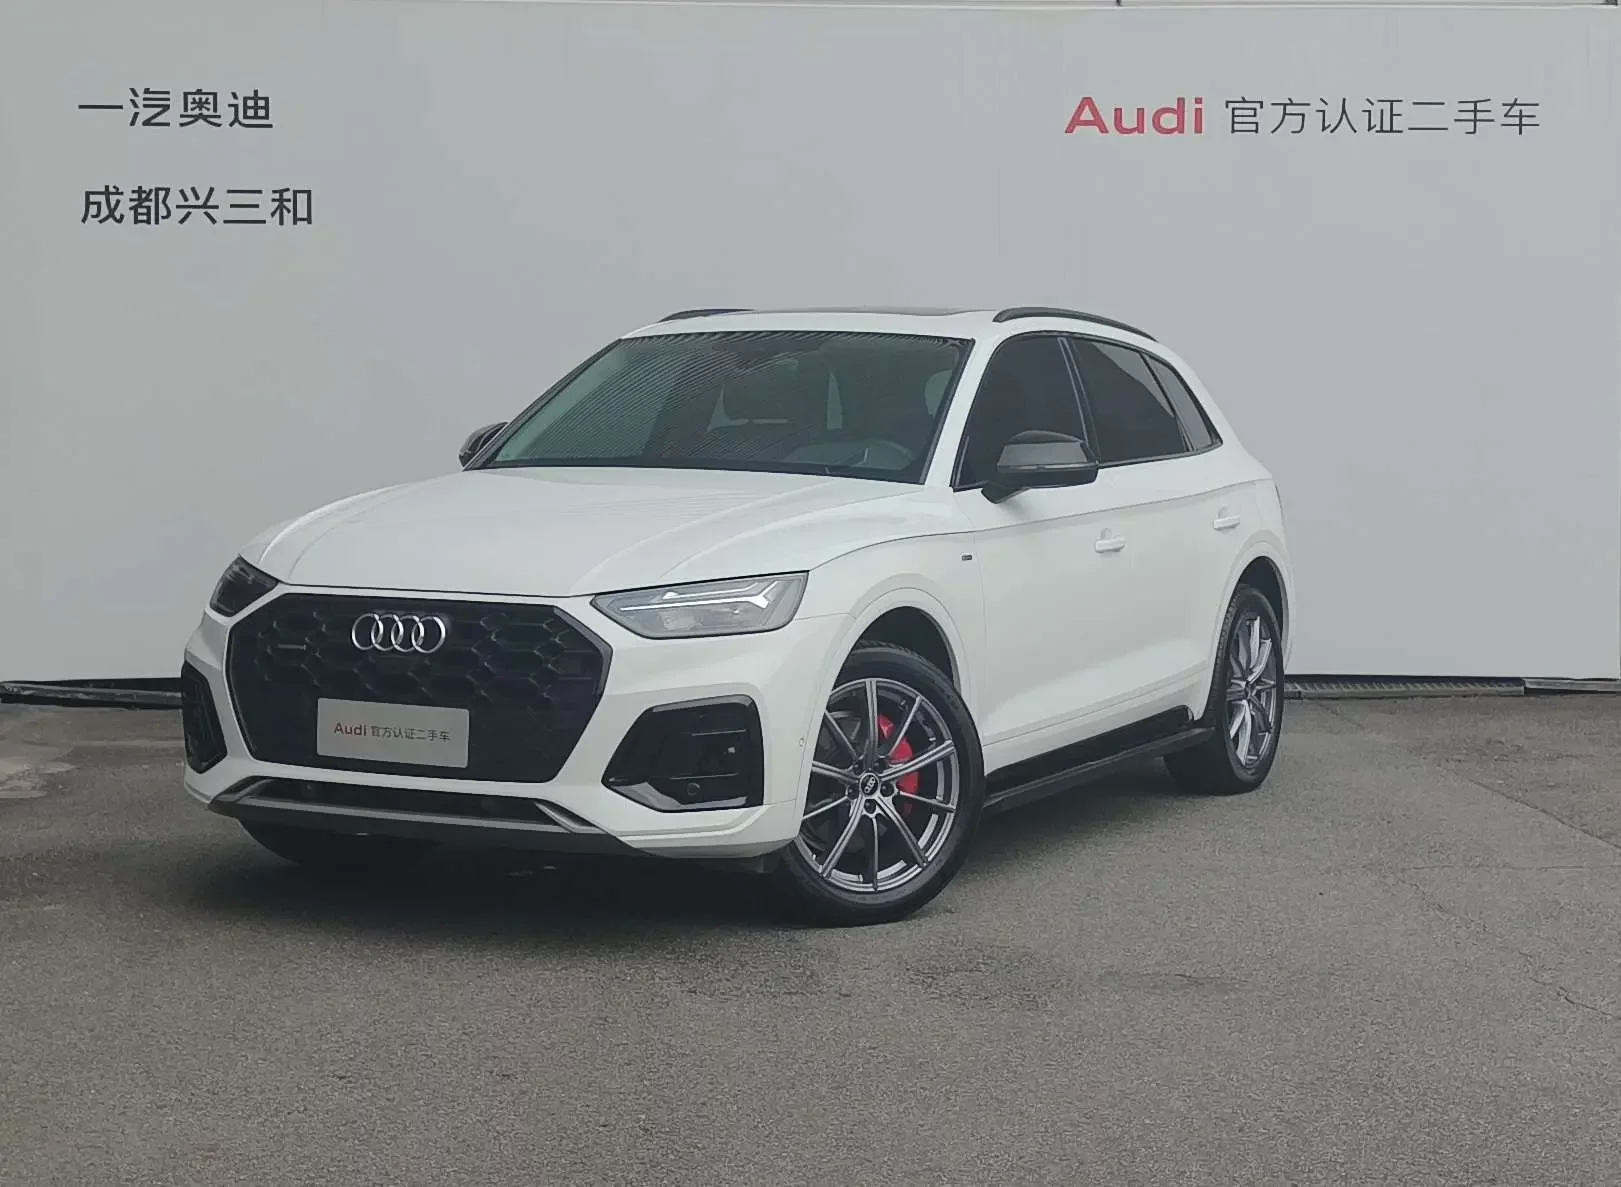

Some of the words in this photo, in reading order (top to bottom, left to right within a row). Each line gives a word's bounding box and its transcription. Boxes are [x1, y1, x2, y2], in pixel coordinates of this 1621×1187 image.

[78, 87, 274, 129] 一汽奥迪
[1064, 97, 1204, 135] Audi
[1225, 96, 1541, 135] 官方认证二手车
[81, 185, 312, 226] 成都兴三和
[333, 721, 367, 737] Audi
[371, 725, 450, 742] 官方认证二手车
